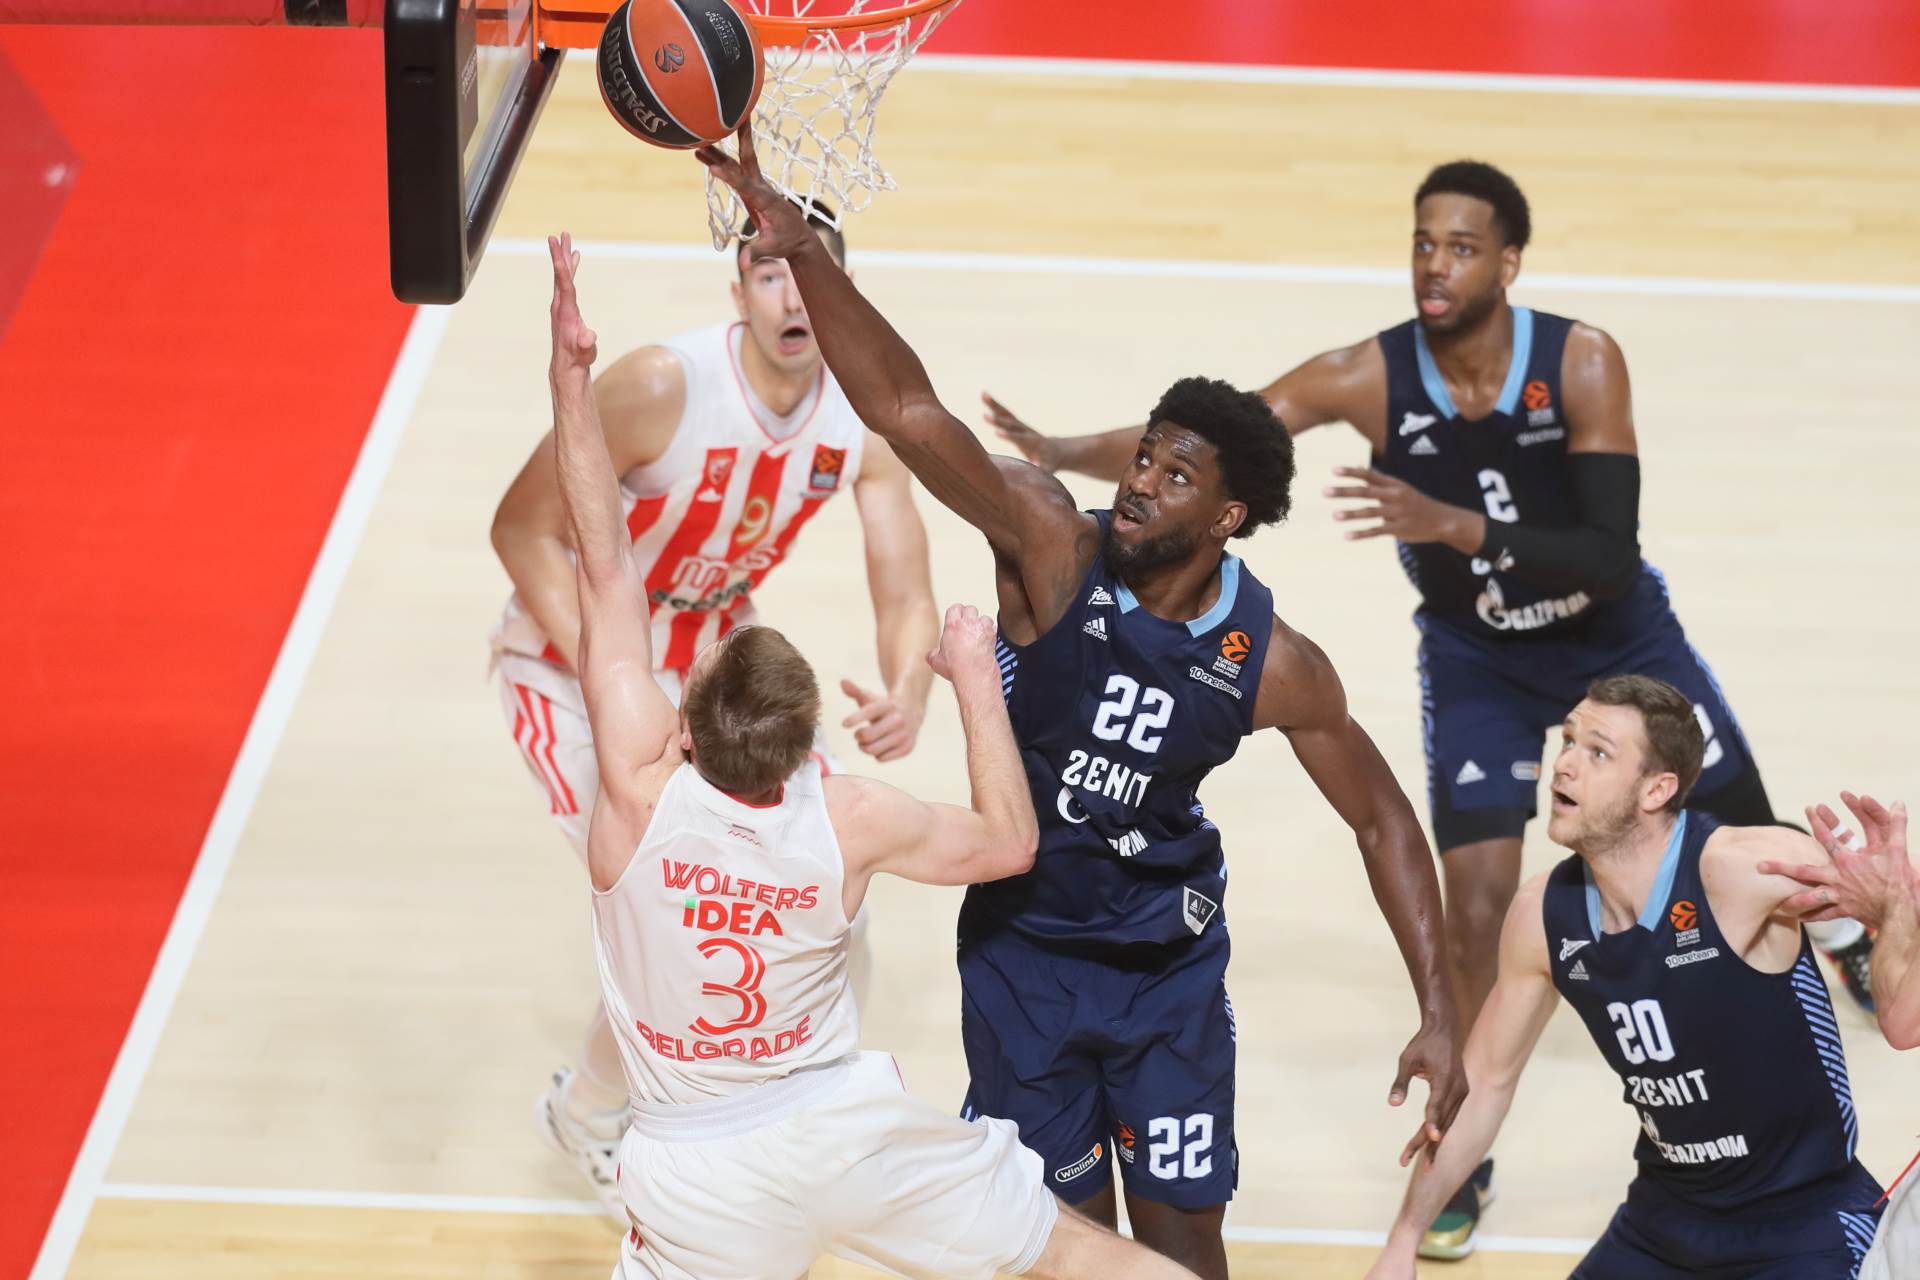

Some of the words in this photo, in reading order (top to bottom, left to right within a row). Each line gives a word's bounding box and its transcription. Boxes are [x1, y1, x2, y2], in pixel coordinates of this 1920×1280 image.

[605, 25, 668, 133] SPALDING
[736, 496, 771, 544] 9
[1477, 468, 1519, 523] 2
[1092, 674, 1175, 753] 22
[1062, 750, 1152, 808] ZENIT
[662, 857, 820, 911] WOLTERS
[688, 937, 767, 1037] 3
[636, 1015, 813, 1062] BELGRADE
[1606, 998, 1676, 1065] 20
[1626, 1068, 1709, 1106] ZENIT
[1060, 1156, 1095, 1179] Winline
[1148, 1113, 1214, 1180] 22
[1667, 1135, 1749, 1164] GAZPROM
